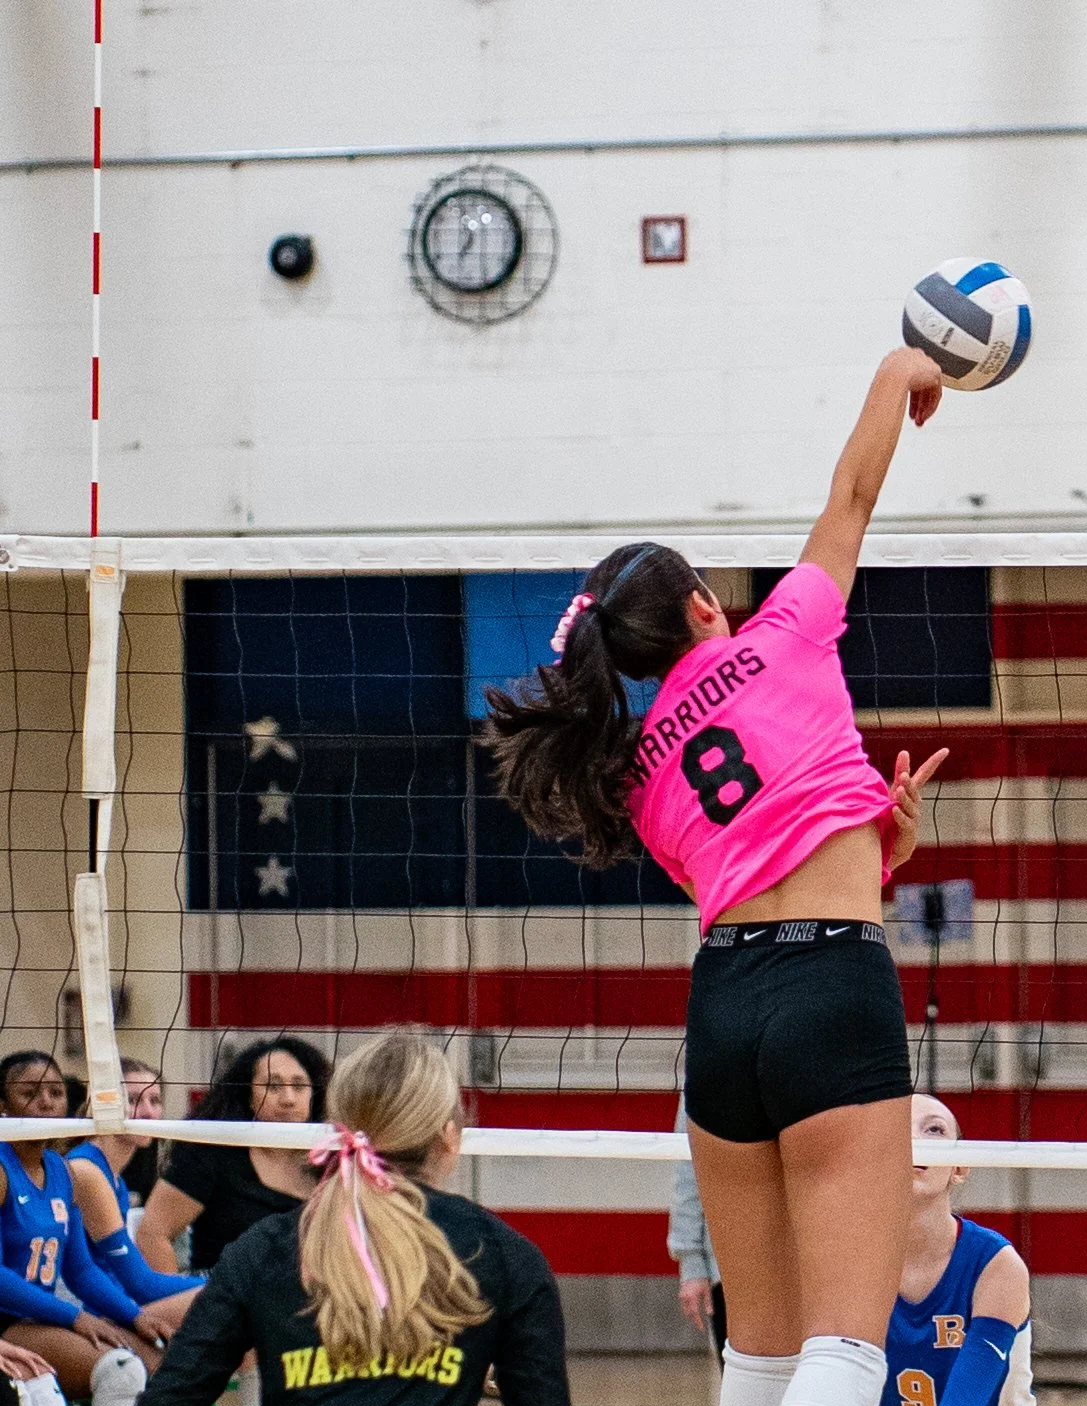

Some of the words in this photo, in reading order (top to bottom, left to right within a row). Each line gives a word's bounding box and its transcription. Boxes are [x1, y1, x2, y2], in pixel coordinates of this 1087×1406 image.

[631, 647, 767, 788] WARRIORS
[680, 724, 764, 826] 8
[775, 921, 818, 943] NIKE
[861, 923, 886, 945] NIK
[26, 1236, 59, 1286] 13
